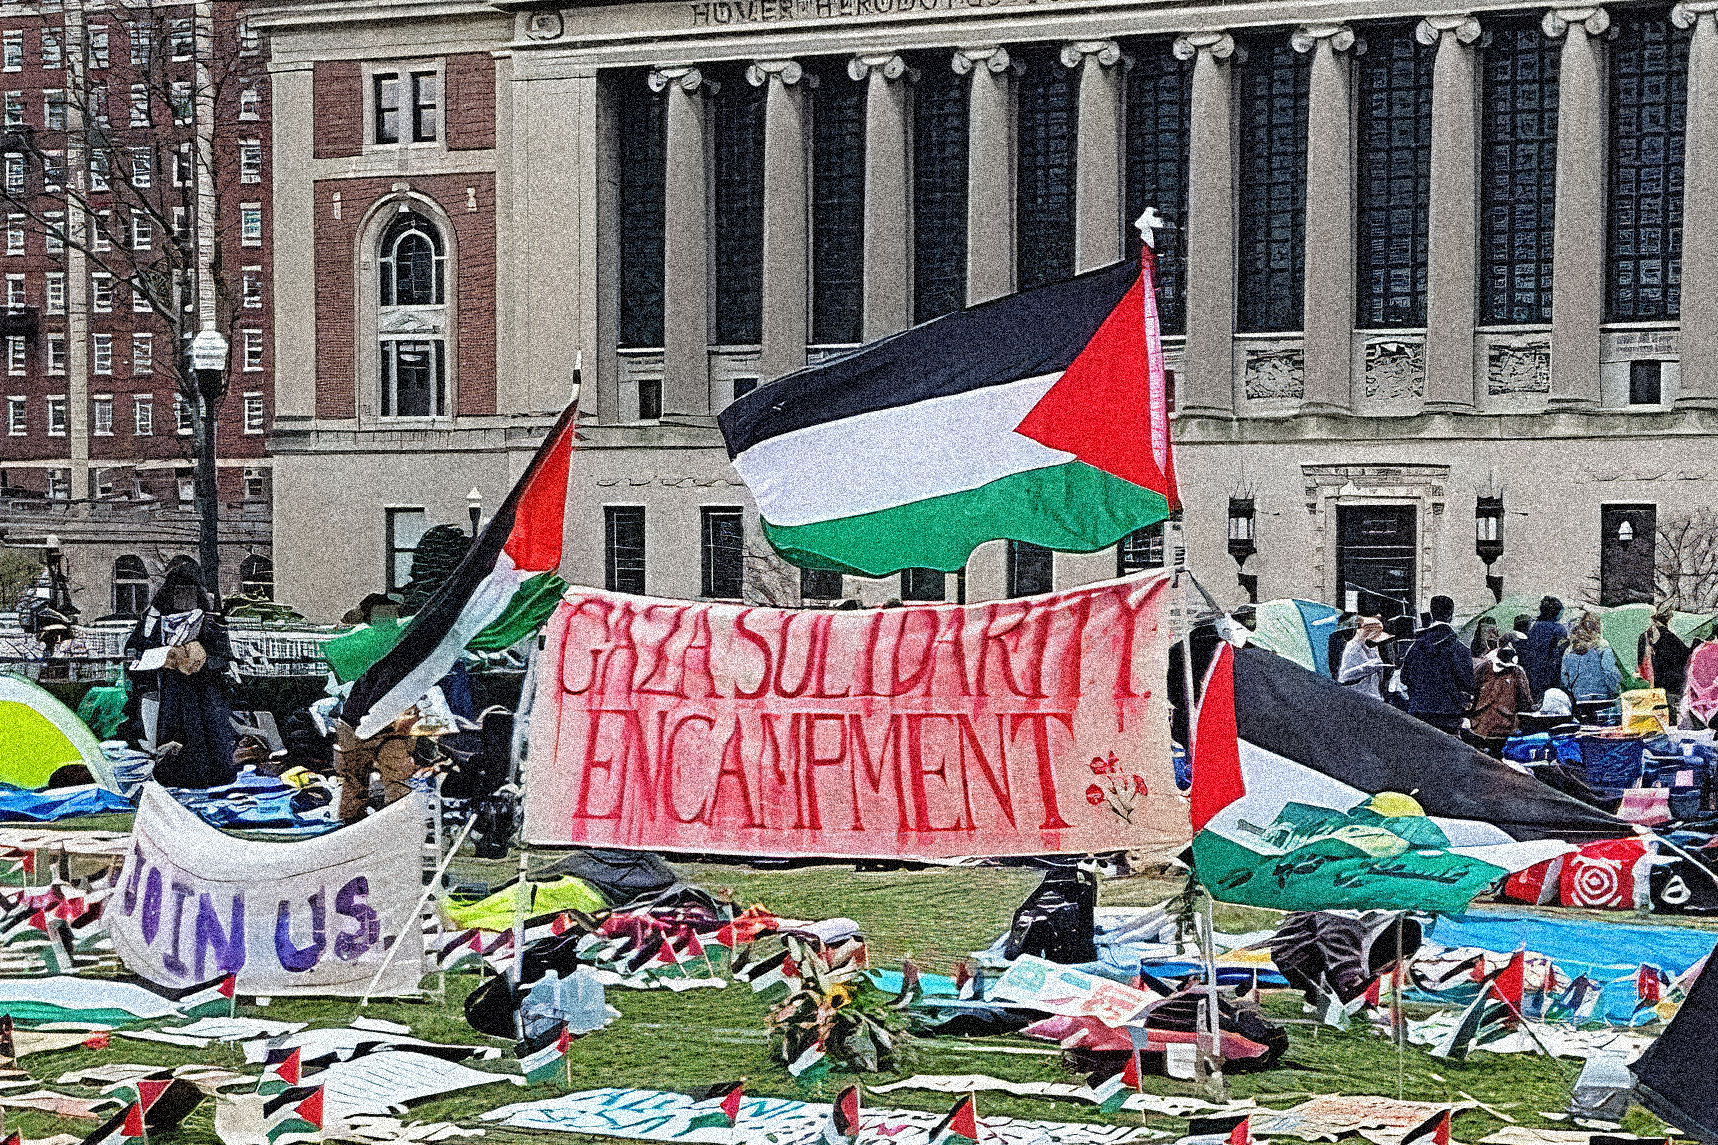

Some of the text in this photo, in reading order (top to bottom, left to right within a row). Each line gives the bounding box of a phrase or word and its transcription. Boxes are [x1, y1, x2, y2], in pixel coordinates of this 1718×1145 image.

[558, 577, 1170, 700] GAZA SOLIDARITY
[573, 708, 1076, 832] ENCAMPMENT
[274, 874, 382, 974] US
